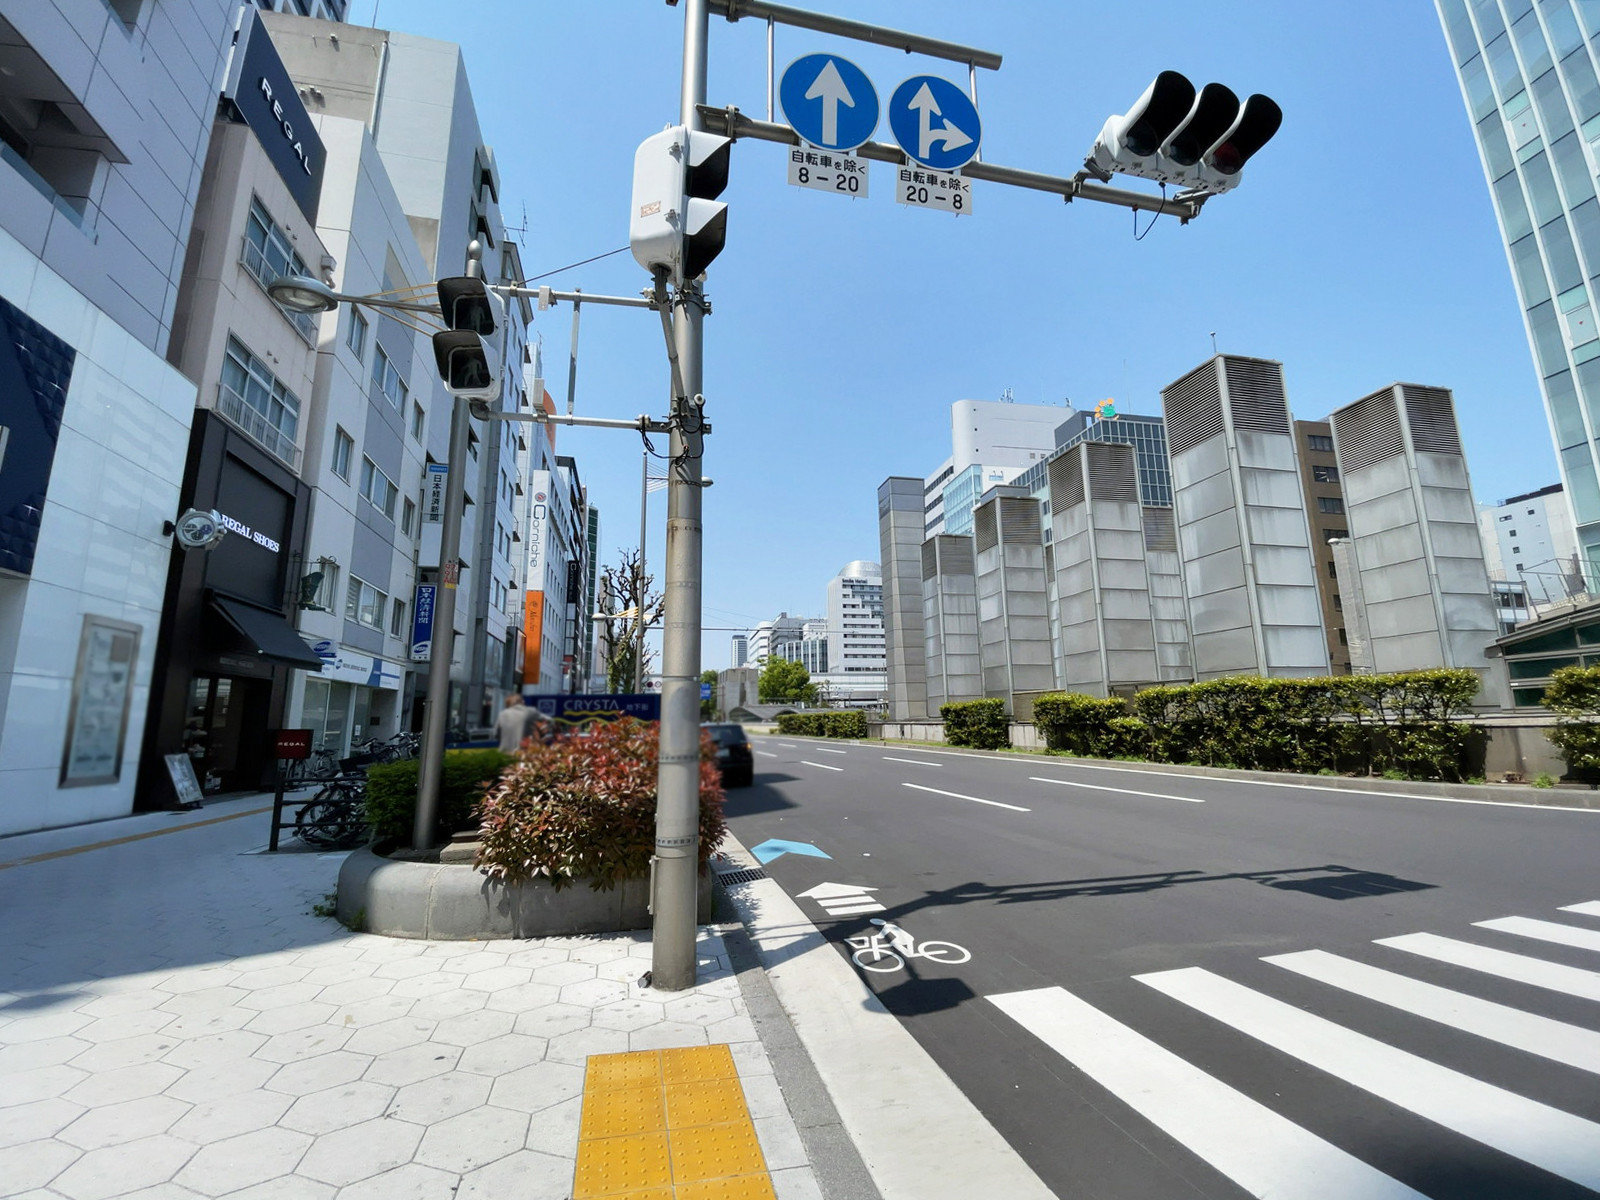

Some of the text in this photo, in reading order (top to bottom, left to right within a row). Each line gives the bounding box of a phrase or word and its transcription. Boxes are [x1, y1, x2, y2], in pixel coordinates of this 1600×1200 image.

[260, 77, 312, 176] REGAL
[792, 150, 866, 175] 自転車を除く
[900, 169, 969, 193] 自転車を除く
[429, 474, 442, 522] 日本経済新聞
[221, 514, 280, 553] REGAL SHOES
[529, 504, 547, 568] Corniche
[563, 699, 620, 711] CRYSTA
